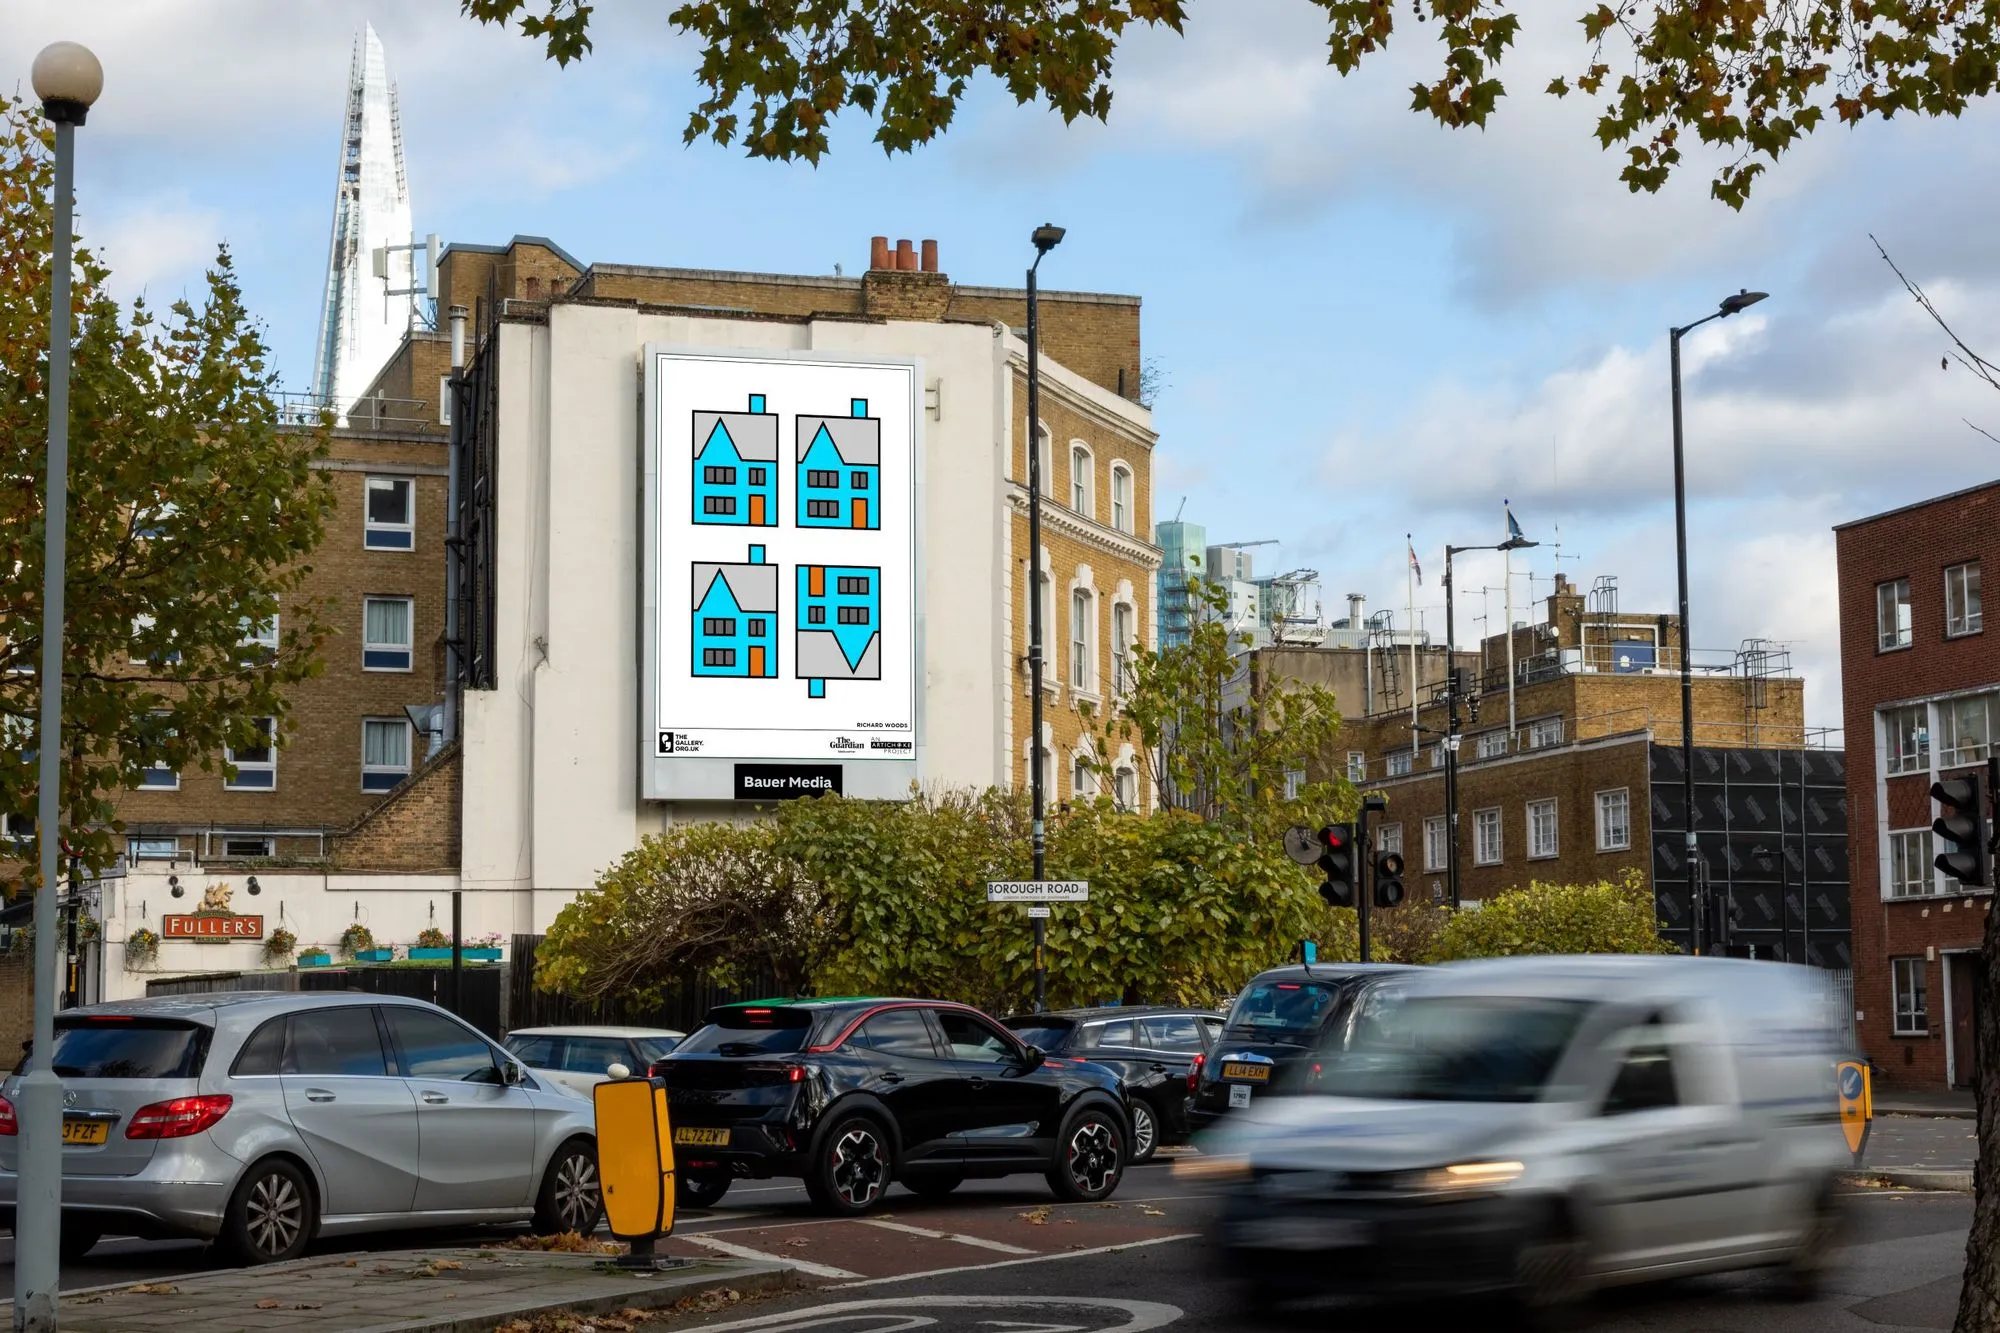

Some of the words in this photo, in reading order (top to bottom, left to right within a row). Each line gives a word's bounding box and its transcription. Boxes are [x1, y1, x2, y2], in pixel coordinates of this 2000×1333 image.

[829, 740, 865, 749] Guardian
[836, 736, 851, 744] The
[744, 776, 786, 788] Bauer
[788, 776, 832, 788] Media
[989, 884, 1043, 894] BOROUGH
[1047, 884, 1079, 894] ROAD
[171, 918, 256, 934] FULLER'S
[73, 1124, 100, 1139] FZF
